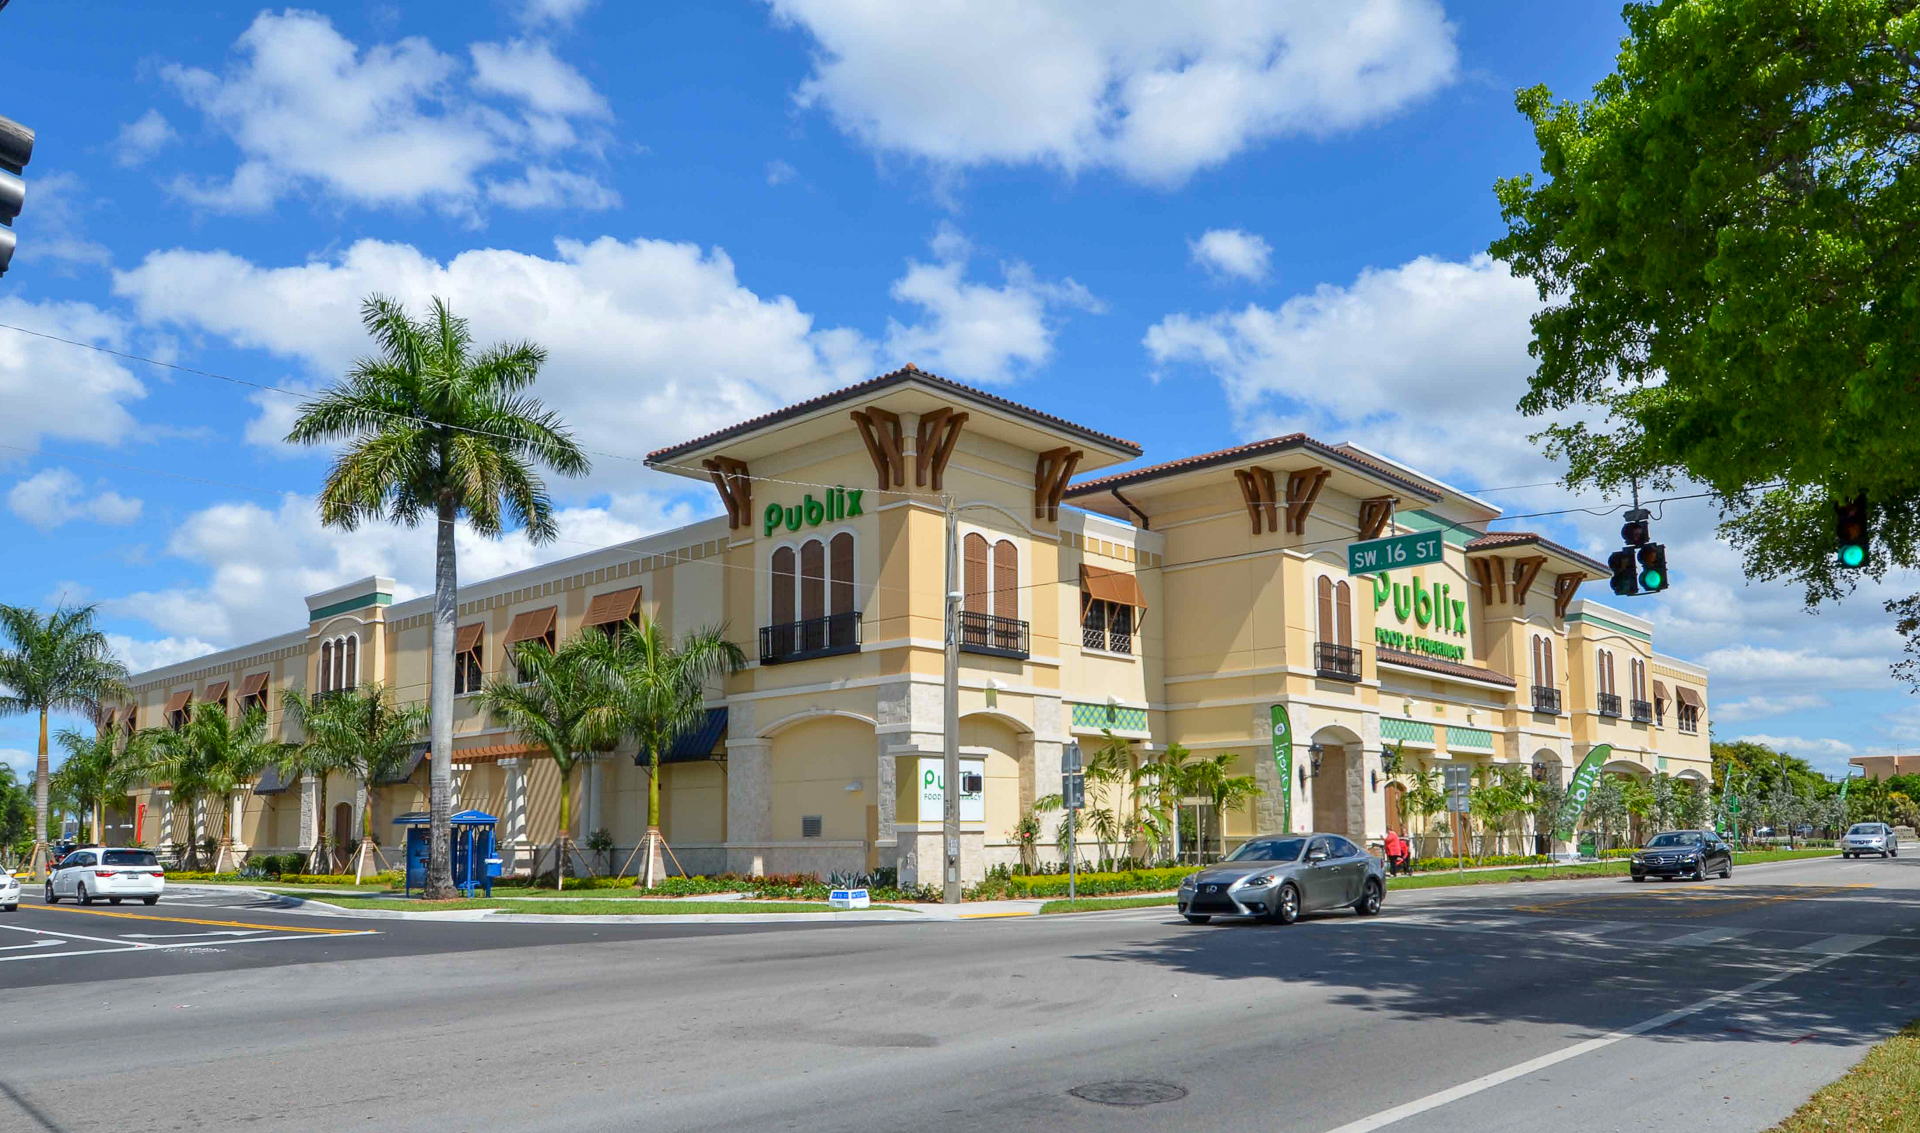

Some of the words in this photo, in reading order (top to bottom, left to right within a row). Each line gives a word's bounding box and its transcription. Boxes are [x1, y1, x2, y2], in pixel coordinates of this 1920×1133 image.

[764, 484, 863, 536] Publix
[1355, 550, 1377, 568] SW
[1386, 543, 1406, 562] 16
[1373, 571, 1467, 634] Publix
[1375, 627, 1404, 647] FOOD
[1406, 634, 1415, 650] &
[1415, 636, 1466, 660] PHARMACY
[924, 793, 942, 801] FOOD
[1562, 762, 1599, 822] ublix
